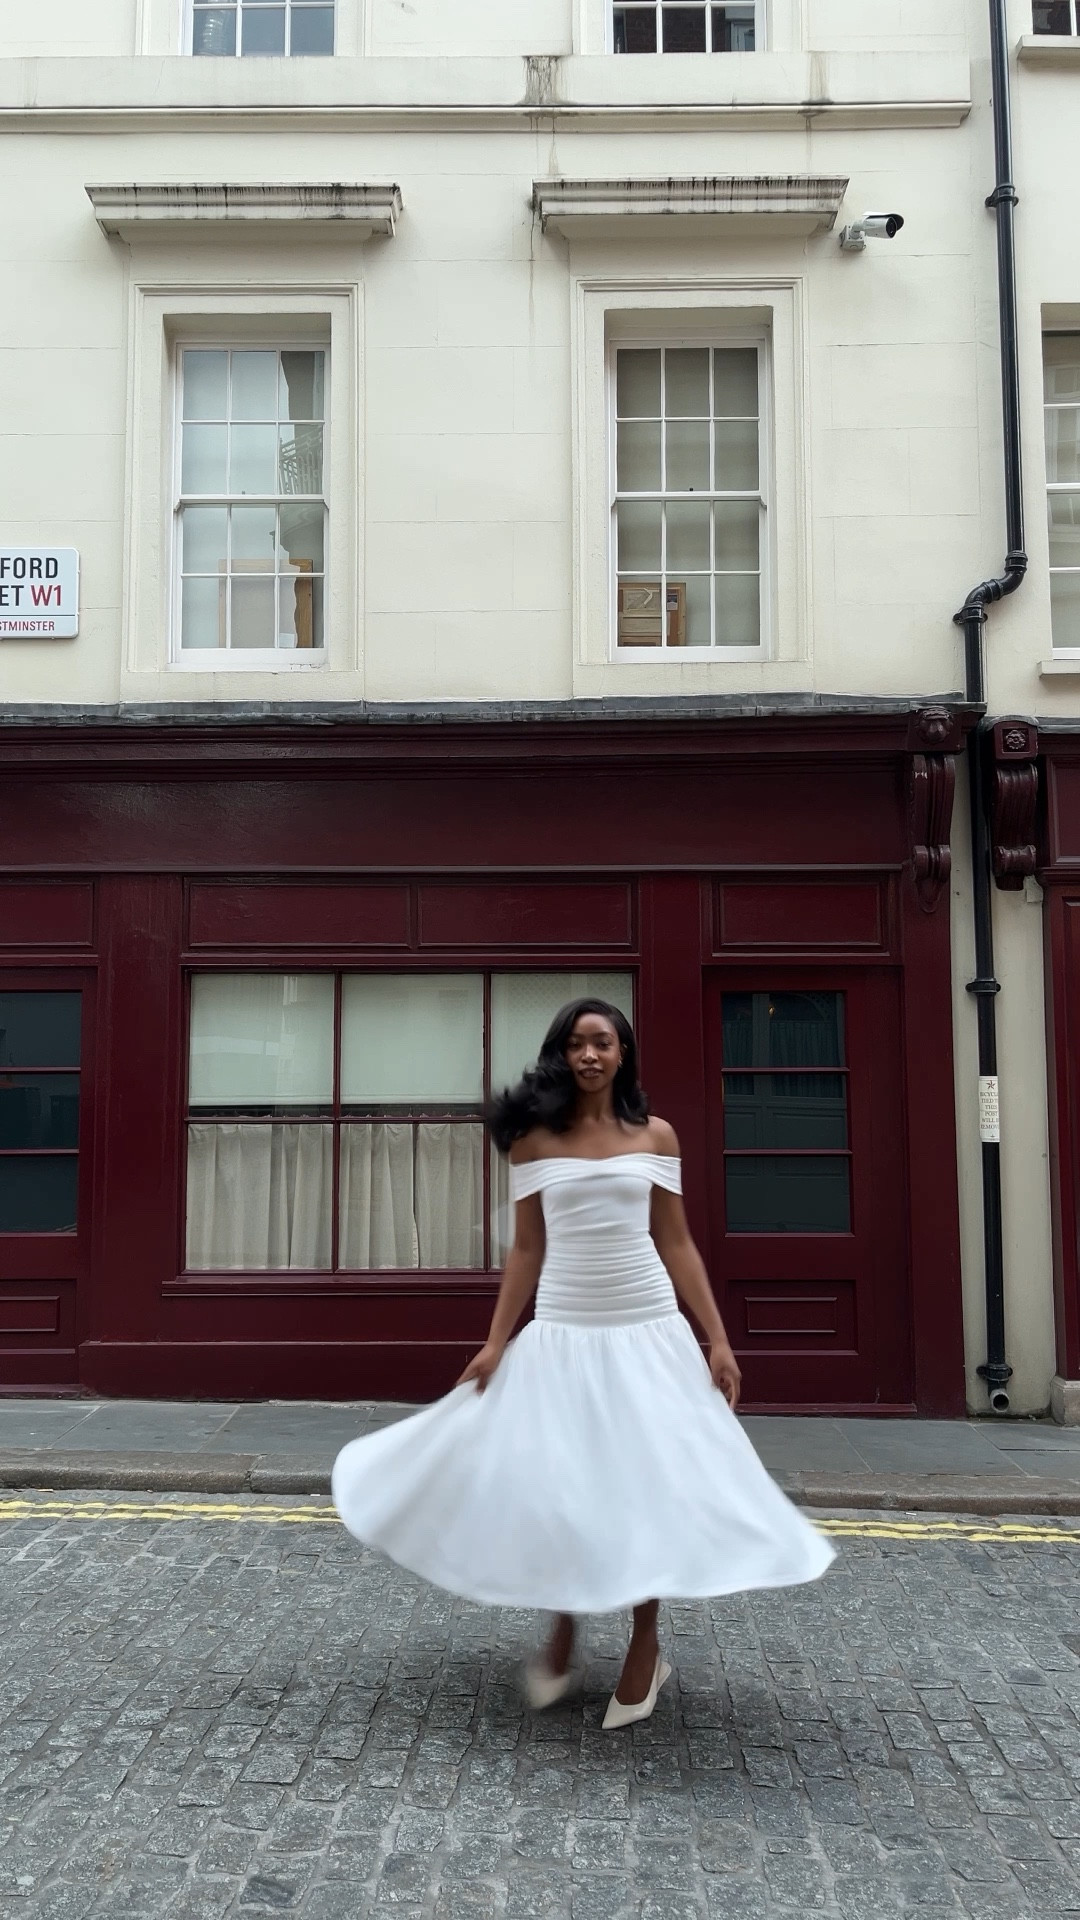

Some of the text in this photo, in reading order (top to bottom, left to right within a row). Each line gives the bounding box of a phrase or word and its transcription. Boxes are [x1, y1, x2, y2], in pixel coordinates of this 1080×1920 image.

[0, 557, 58, 579] FORD
[31, 585, 61, 606] W1
[0, 621, 55, 631] TMINSTER
